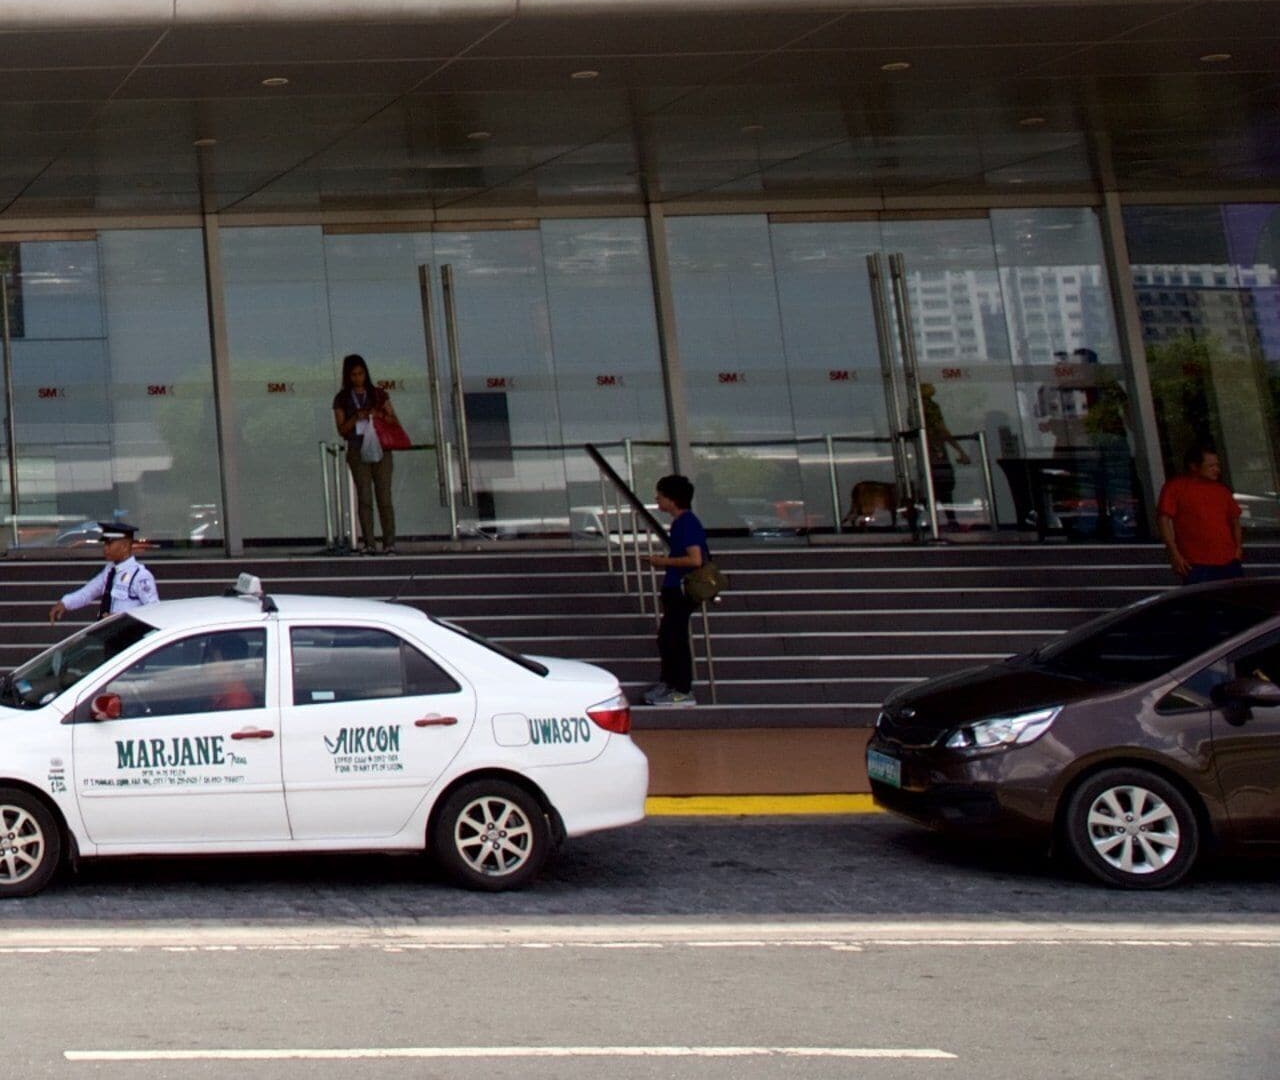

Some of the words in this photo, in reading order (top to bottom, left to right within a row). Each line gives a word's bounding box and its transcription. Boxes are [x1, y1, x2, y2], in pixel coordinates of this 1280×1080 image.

[718, 372, 746, 383] SMX
[829, 371, 857, 381] SMX
[942, 368, 970, 378] SMX
[487, 378, 515, 388] SMX
[595, 375, 624, 386] SMX
[38, 388, 66, 398] SMX
[147, 385, 175, 396] SMX
[267, 382, 295, 393] SMX
[529, 717, 591, 745] UWA870
[324, 725, 401, 754] AIRCON
[115, 735, 225, 769] MARJANE
